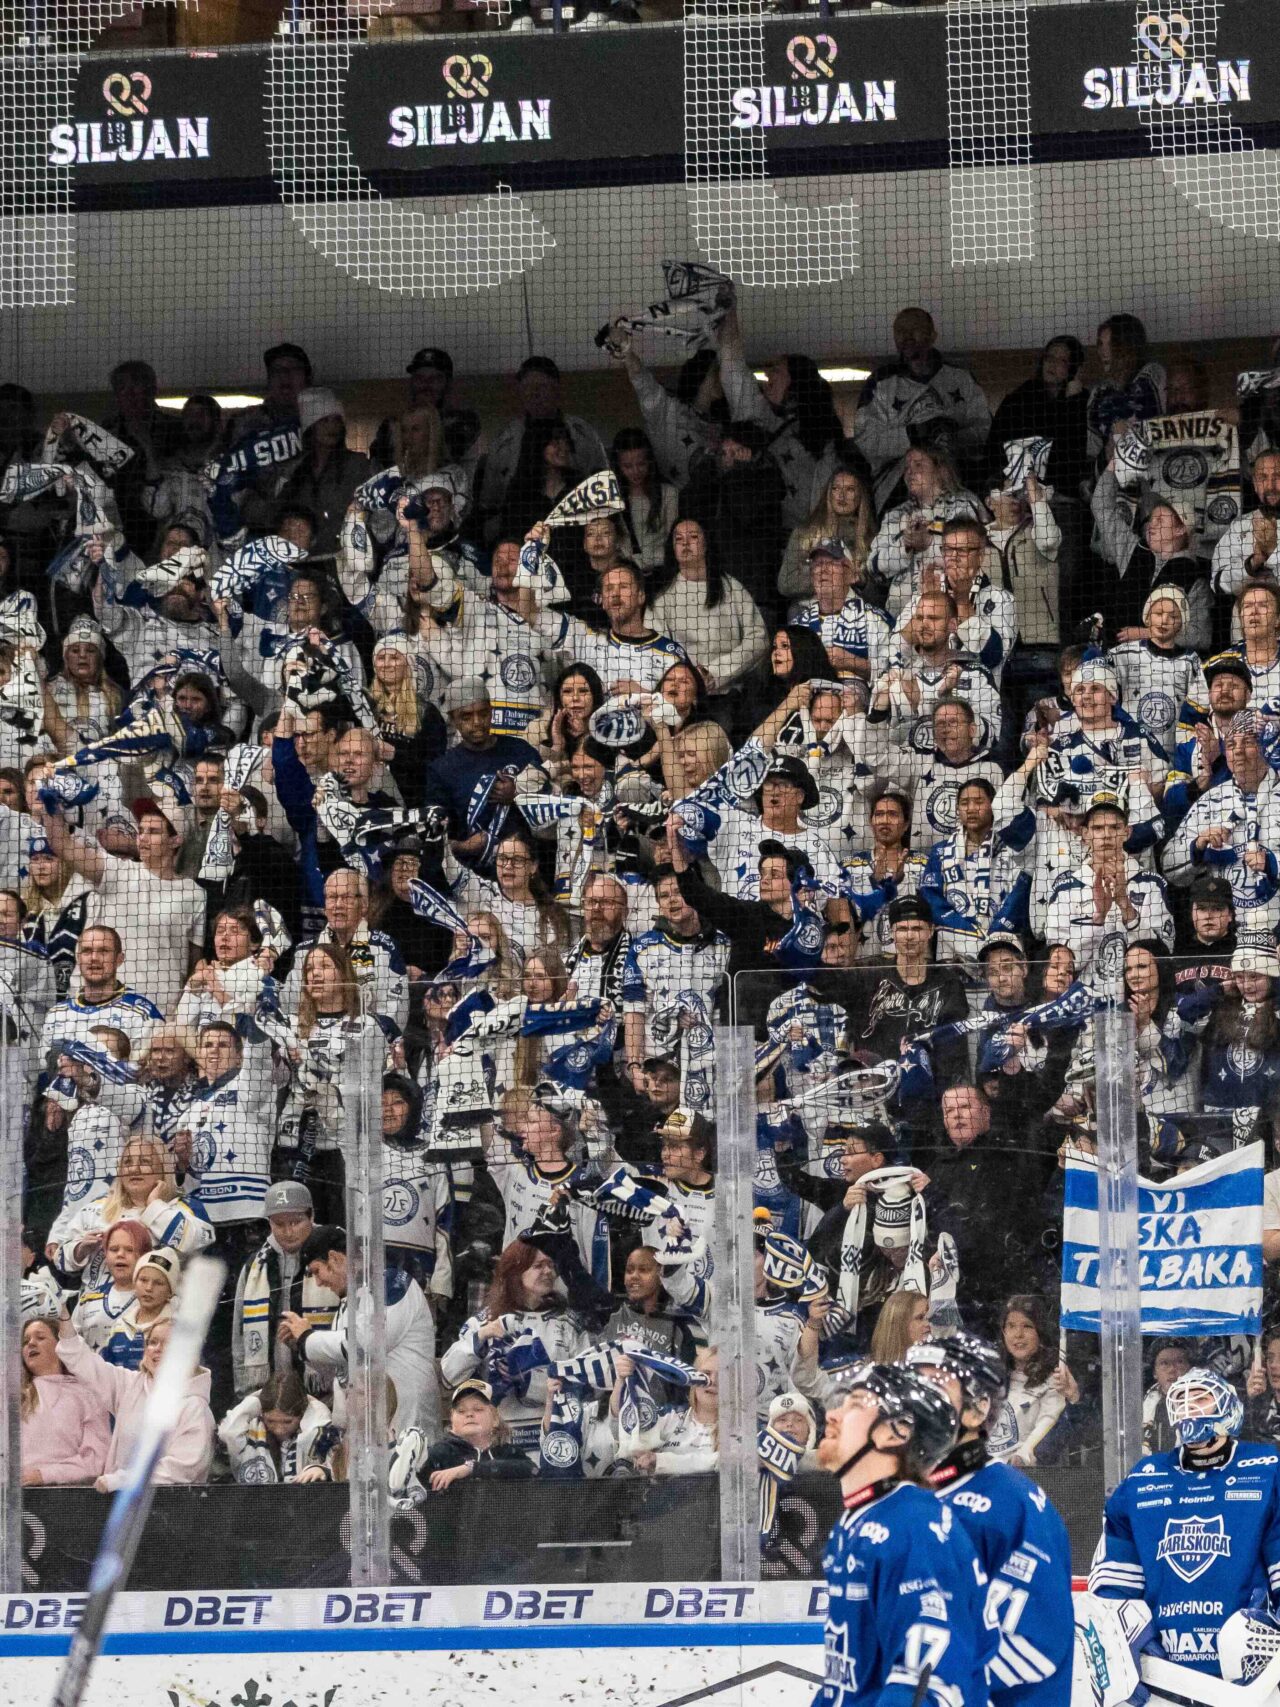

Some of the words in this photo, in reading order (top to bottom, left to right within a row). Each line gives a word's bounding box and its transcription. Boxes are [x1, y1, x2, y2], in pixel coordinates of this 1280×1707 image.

[1082, 59, 1250, 109] SILJAN
[730, 80, 897, 129] SILJAN
[387, 99, 551, 148] SILJAN
[48, 117, 209, 164] SILJAN
[1147, 1190, 1185, 1214] VI
[1137, 1215, 1201, 1248] SKA
[1073, 1250, 1253, 1290] TLBAKA
[1237, 1455, 1279, 1468] coop
[1179, 1494, 1215, 1504] Helmia
[1184, 1524, 1203, 1534] BIK
[1158, 1535, 1230, 1555] KARLSKOGA
[5, 1598, 88, 1629] DBE
[164, 1595, 272, 1627] DBET
[324, 1592, 432, 1624] DBET
[484, 1589, 594, 1620] DBET
[644, 1587, 755, 1618] DBET
[1160, 1629, 1217, 1654] MAX
